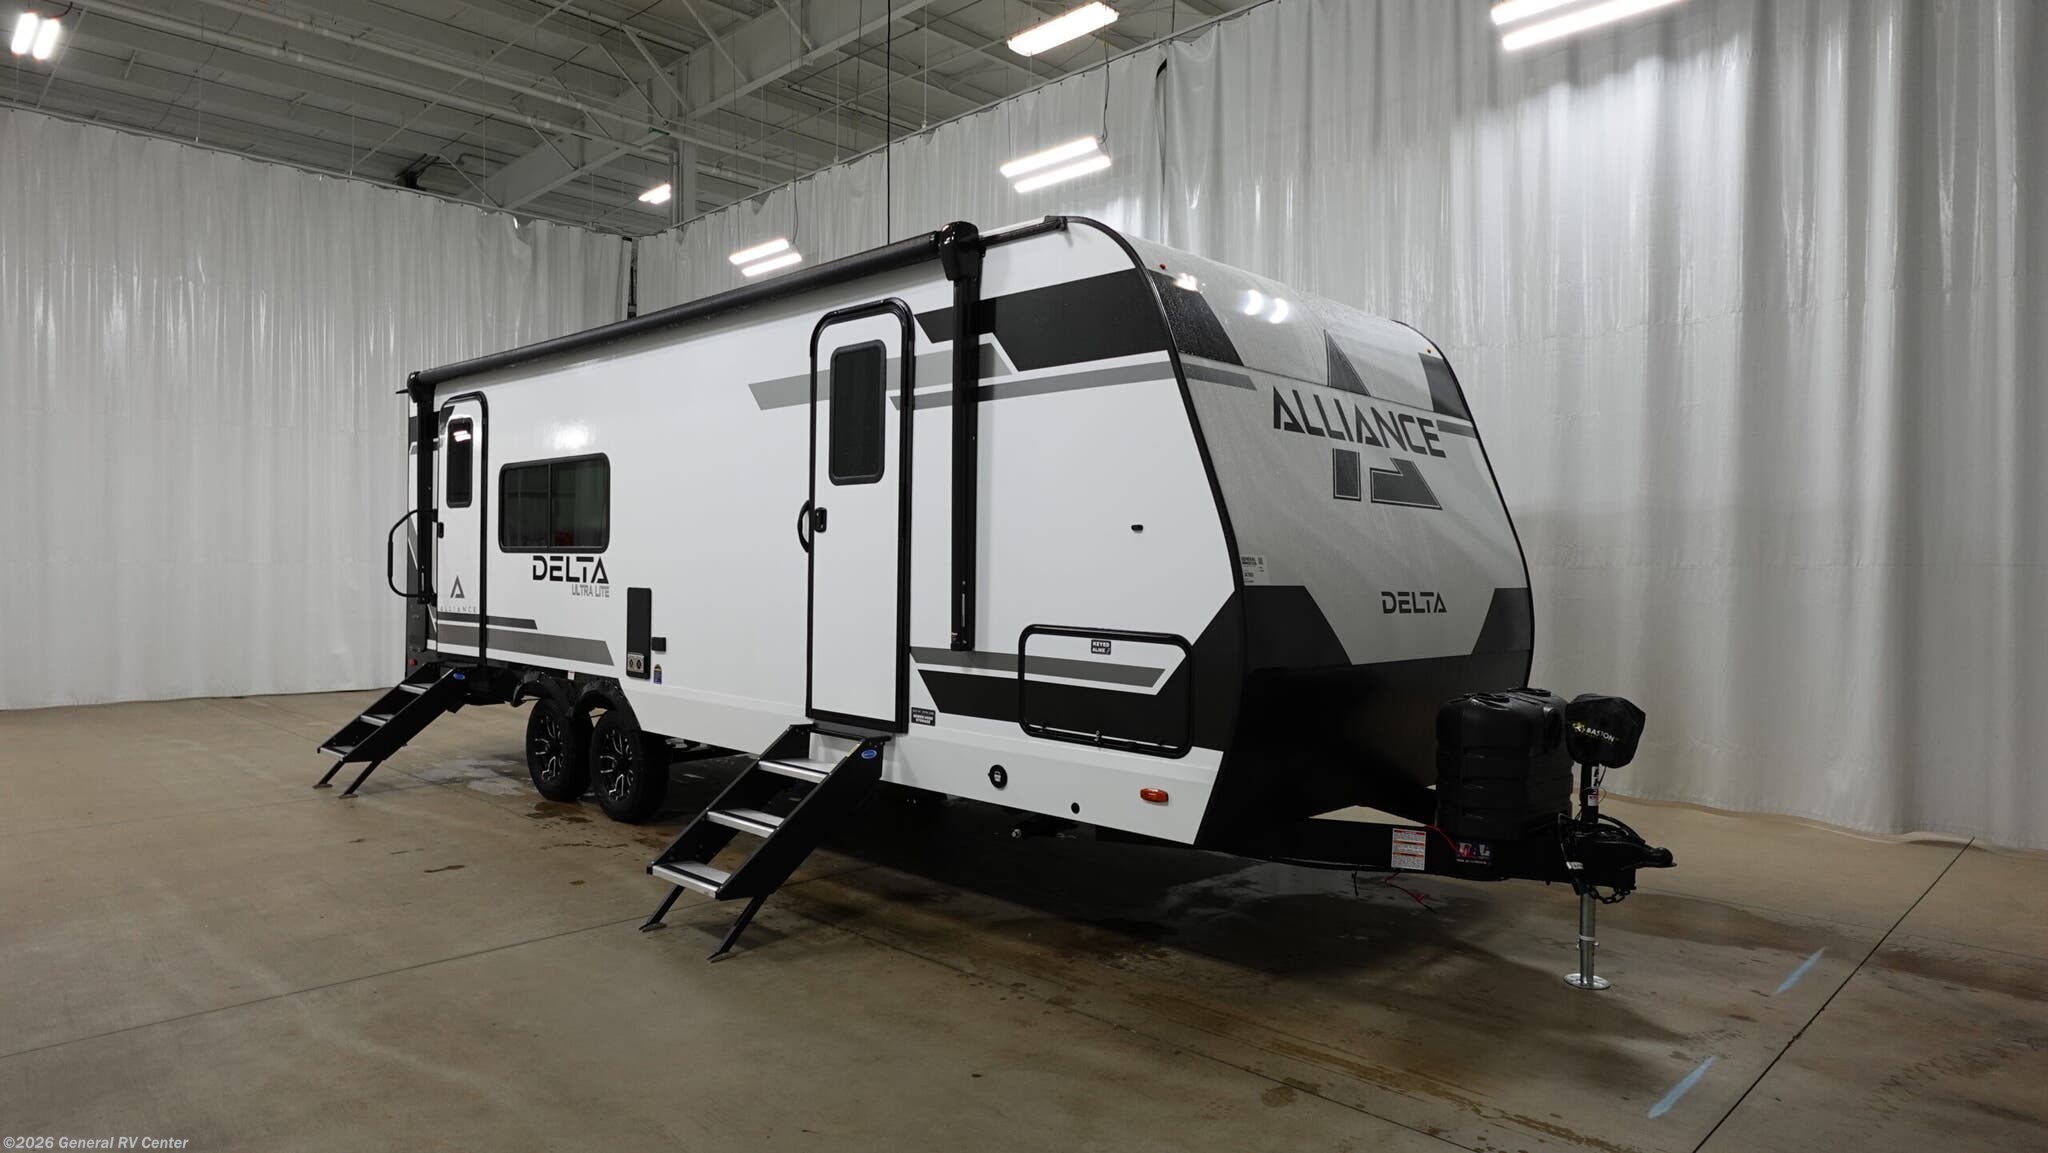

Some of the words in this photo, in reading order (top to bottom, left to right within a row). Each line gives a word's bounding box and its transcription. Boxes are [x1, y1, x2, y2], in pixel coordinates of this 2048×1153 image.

[1273, 386, 1447, 458] ALLIANCE
[532, 555, 609, 584] DELTA
[571, 584, 594, 597] ULTRA
[595, 586, 610, 598] LITE
[1381, 591, 1447, 614] DELTA
